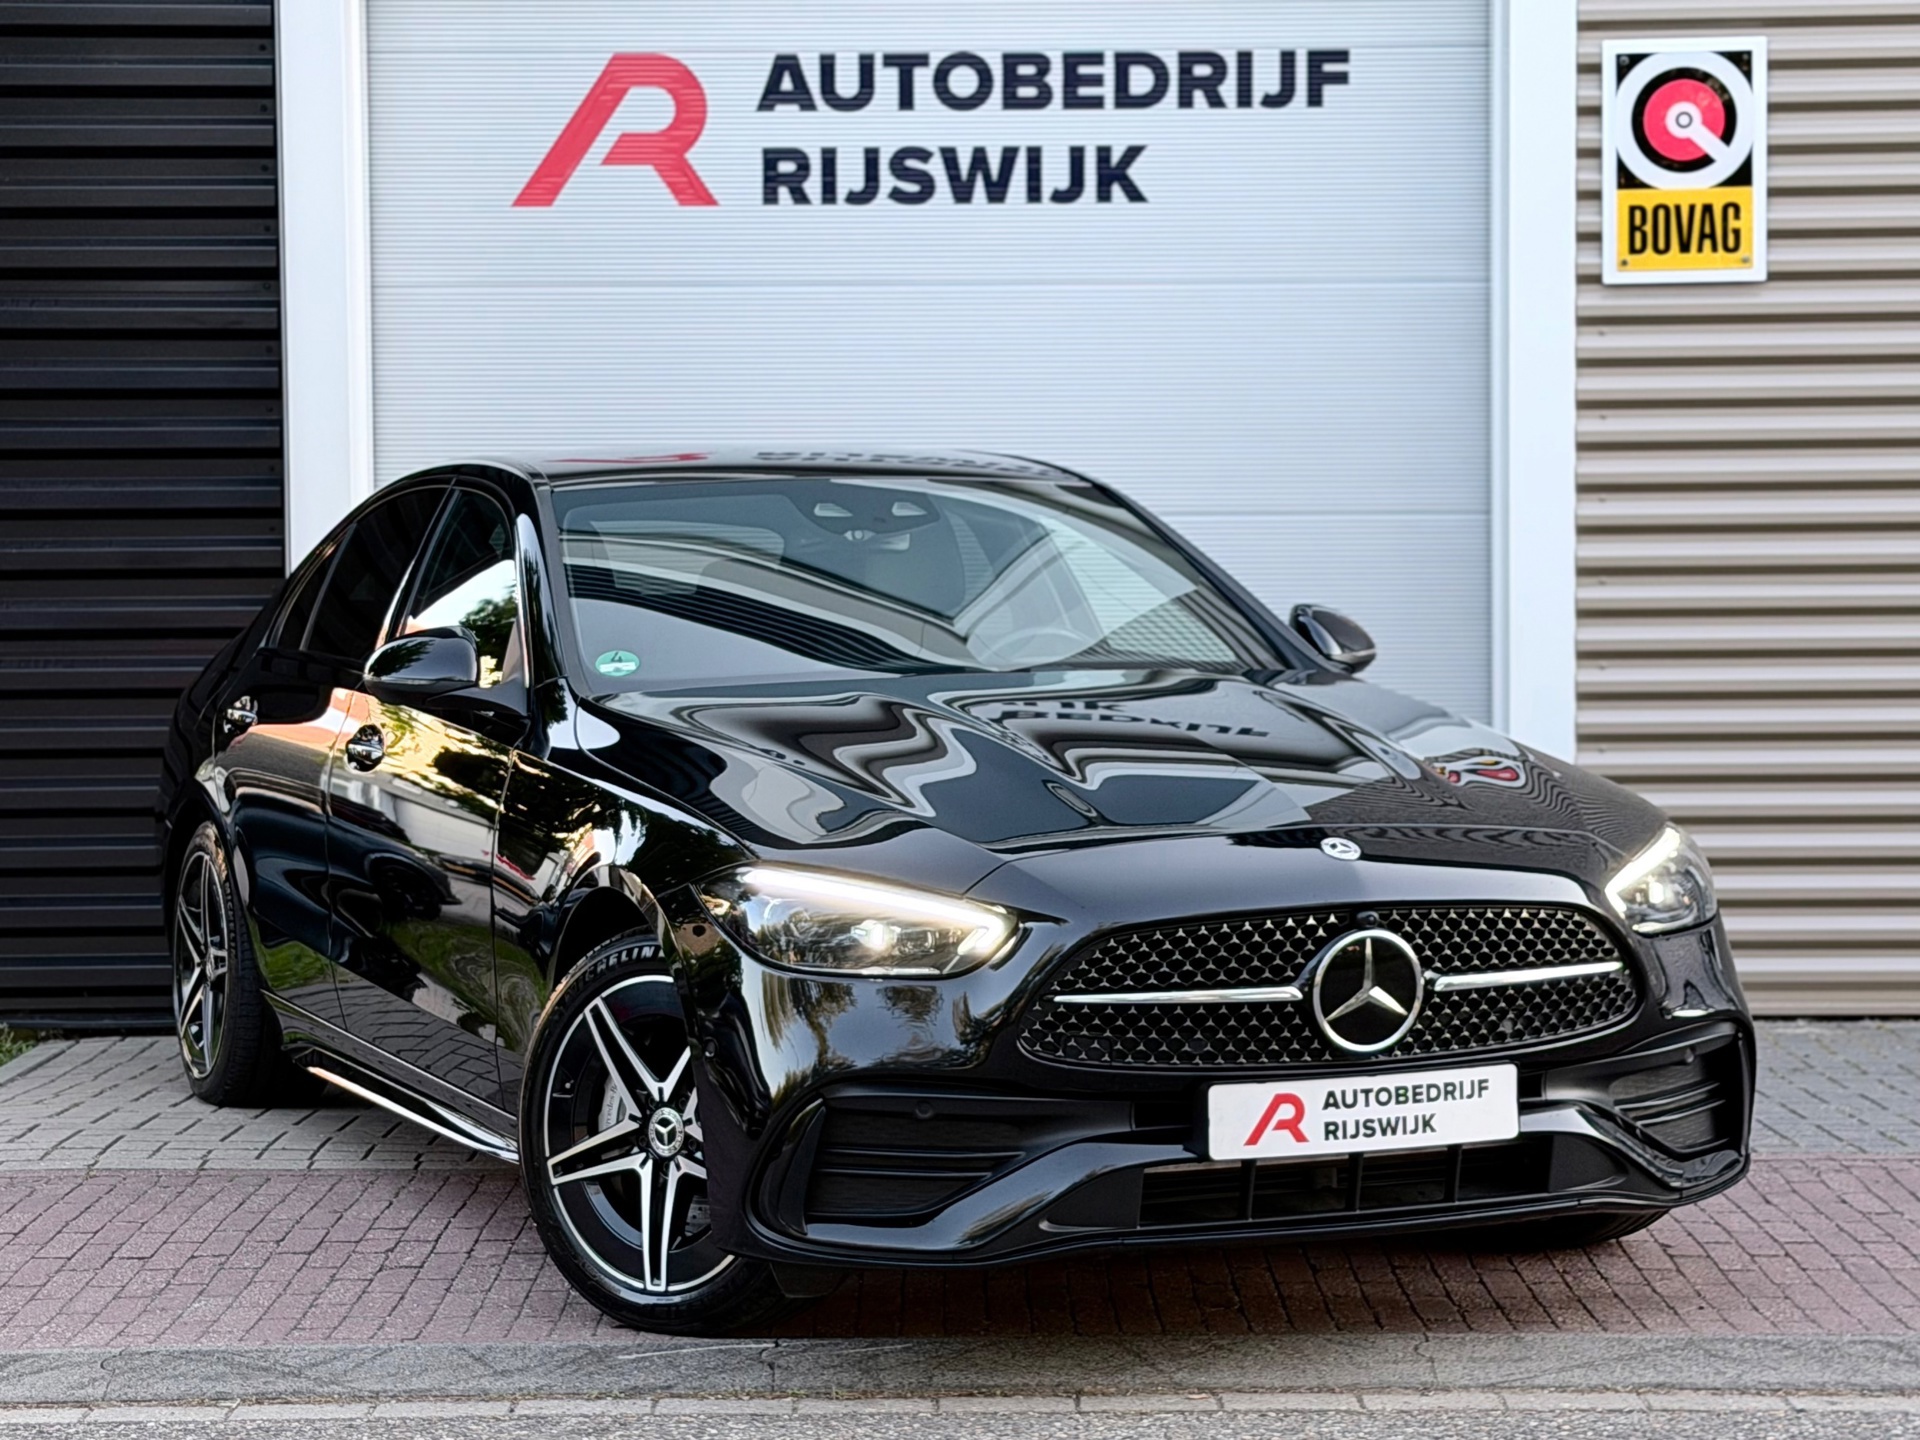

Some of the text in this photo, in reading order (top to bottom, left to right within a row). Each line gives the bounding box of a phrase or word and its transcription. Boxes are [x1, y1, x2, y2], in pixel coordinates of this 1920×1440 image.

[757, 49, 1350, 112] AUTOBEDRIJF
[762, 145, 1147, 206] RIJSWIJK
[1628, 202, 1741, 256] BOVAG
[1321, 1078, 1490, 1111] AUTOBEDRIJF
[1323, 1114, 1437, 1141] RIJSWIJK
